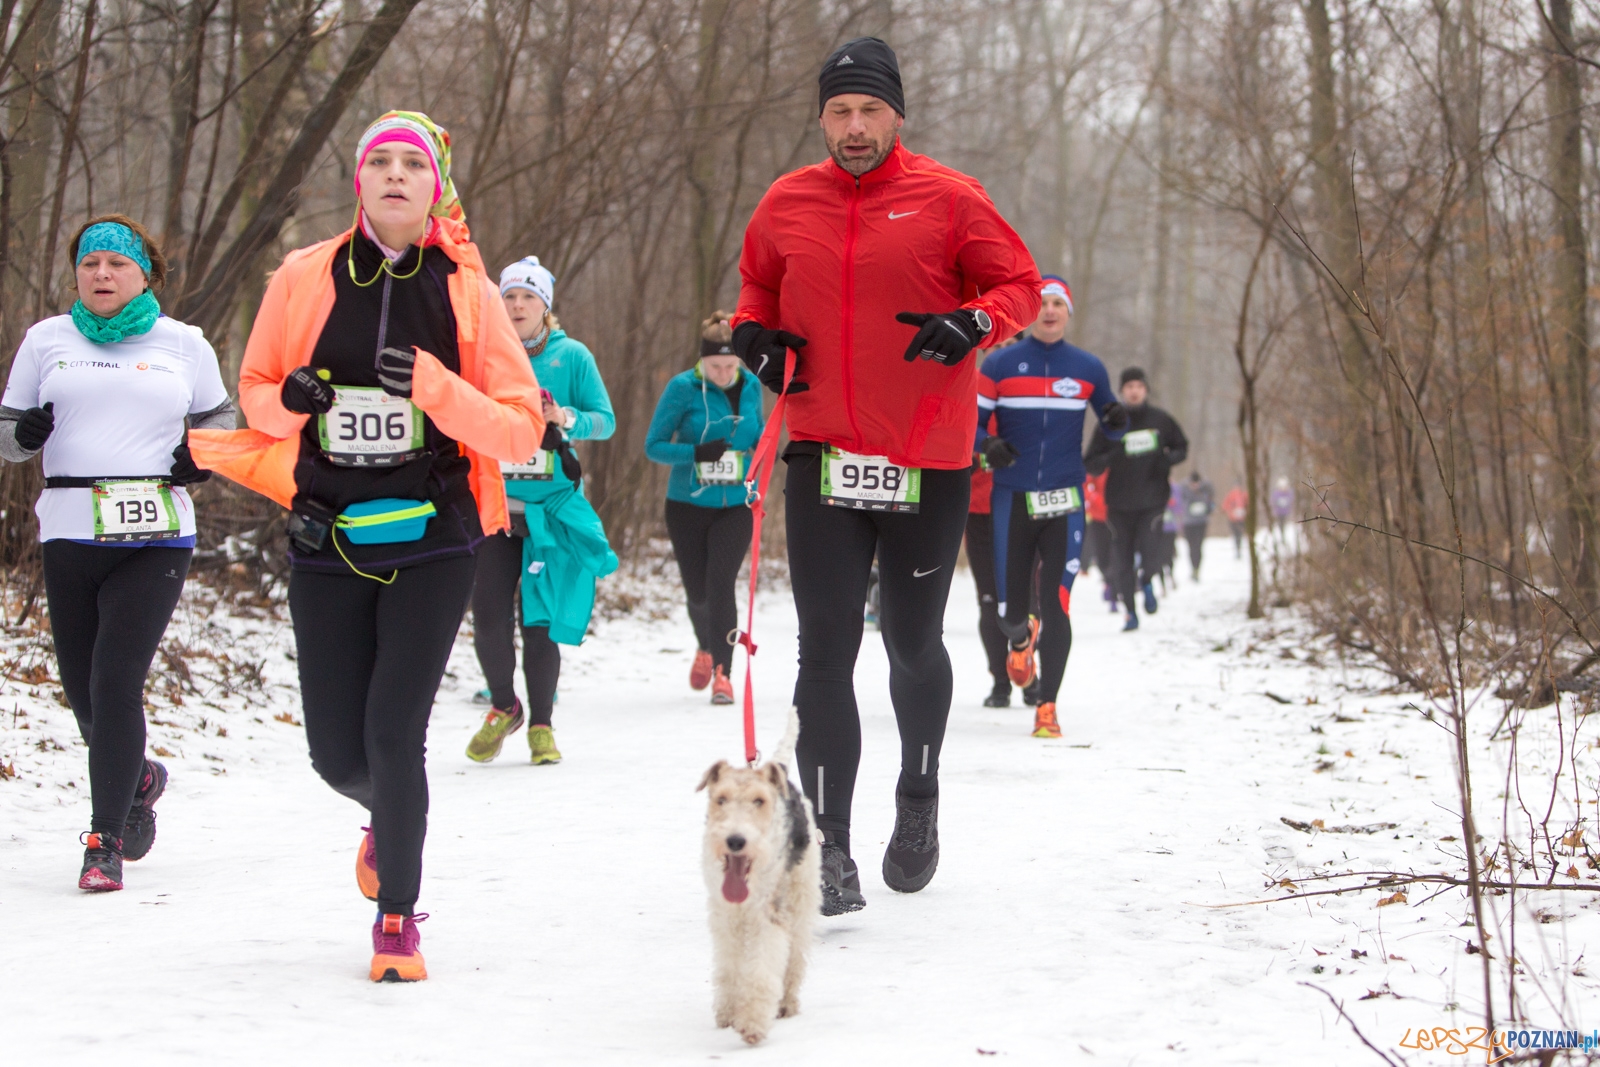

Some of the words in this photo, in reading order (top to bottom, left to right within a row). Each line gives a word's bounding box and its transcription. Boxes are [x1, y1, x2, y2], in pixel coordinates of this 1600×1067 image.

[338, 411, 405, 441] 306
[347, 444, 398, 452] MAGDALENA
[706, 460, 734, 474] 393
[842, 464, 901, 491] 958
[856, 492, 884, 500] MARCIN
[1038, 490, 1068, 506] 863
[115, 500, 158, 524] 139
